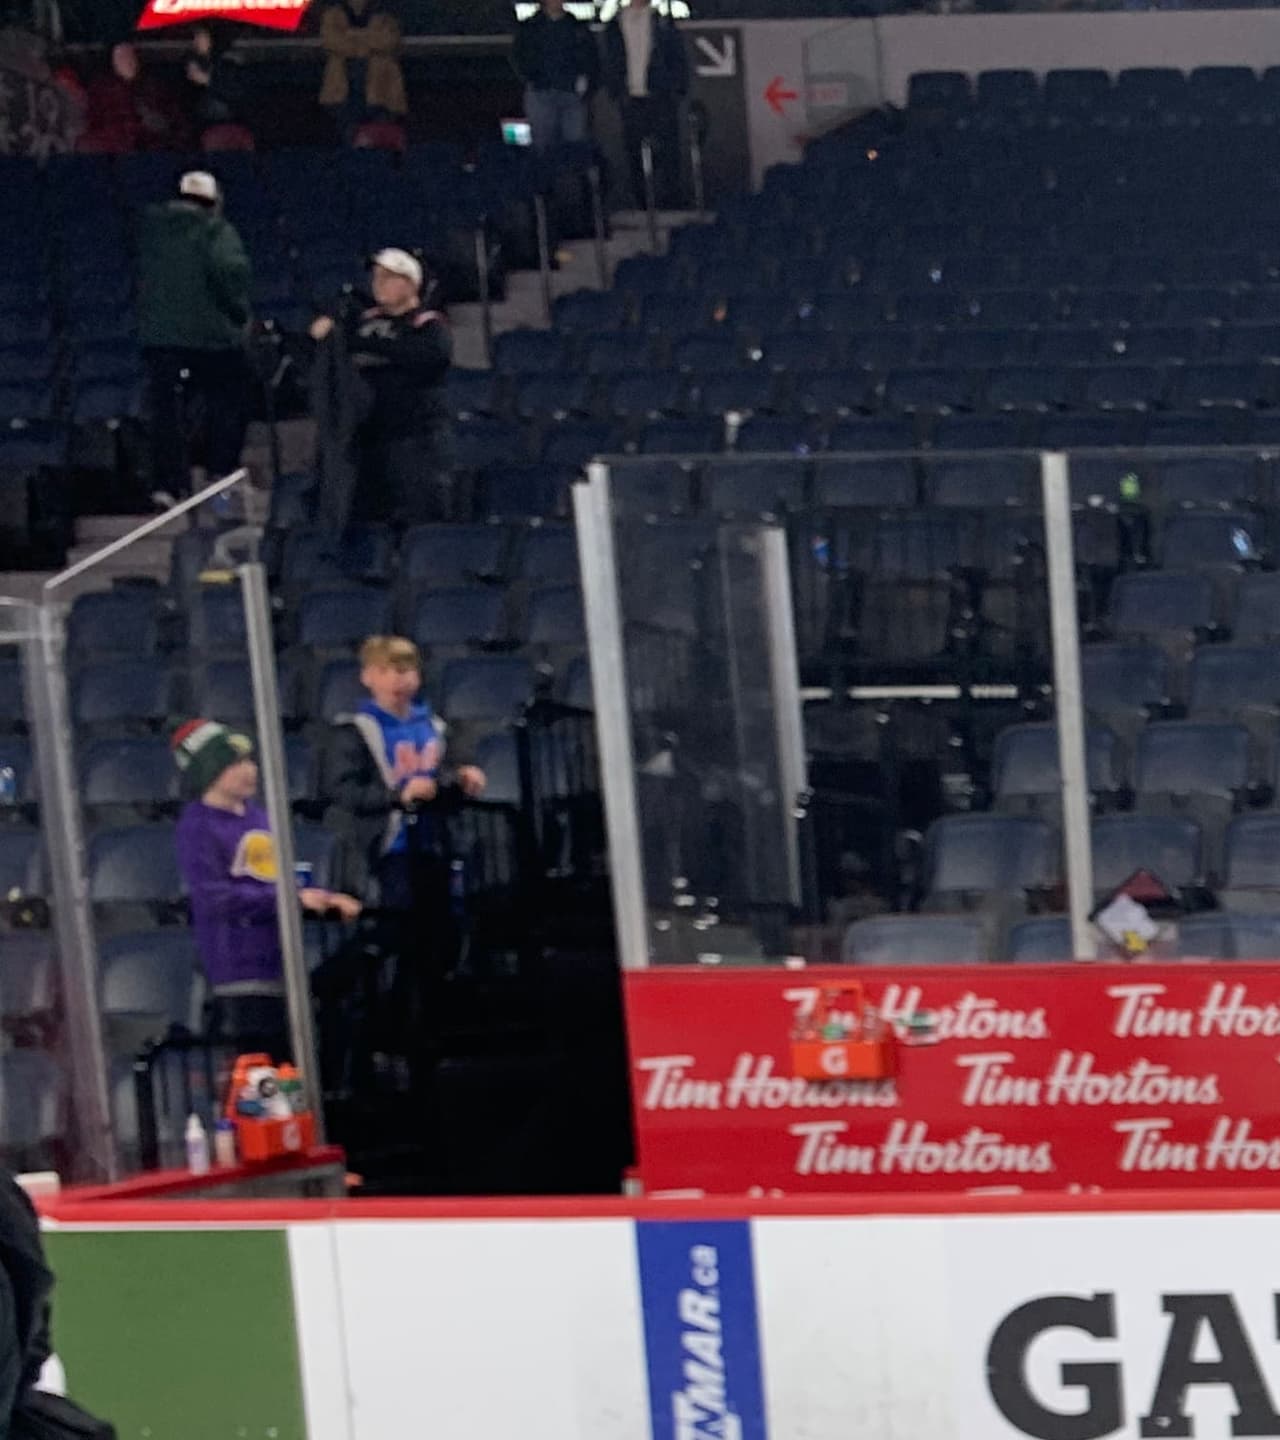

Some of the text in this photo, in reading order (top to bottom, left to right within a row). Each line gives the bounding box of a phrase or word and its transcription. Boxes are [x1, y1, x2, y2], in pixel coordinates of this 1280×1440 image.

[1107, 984, 1192, 1038] Tim
[638, 1055, 722, 1110] Tim
[820, 1046, 849, 1074] G
[956, 1049, 1222, 1106] Tim Hortons
[789, 1118, 1053, 1174] Tim Hortons
[1113, 1118, 1197, 1171] Tim
